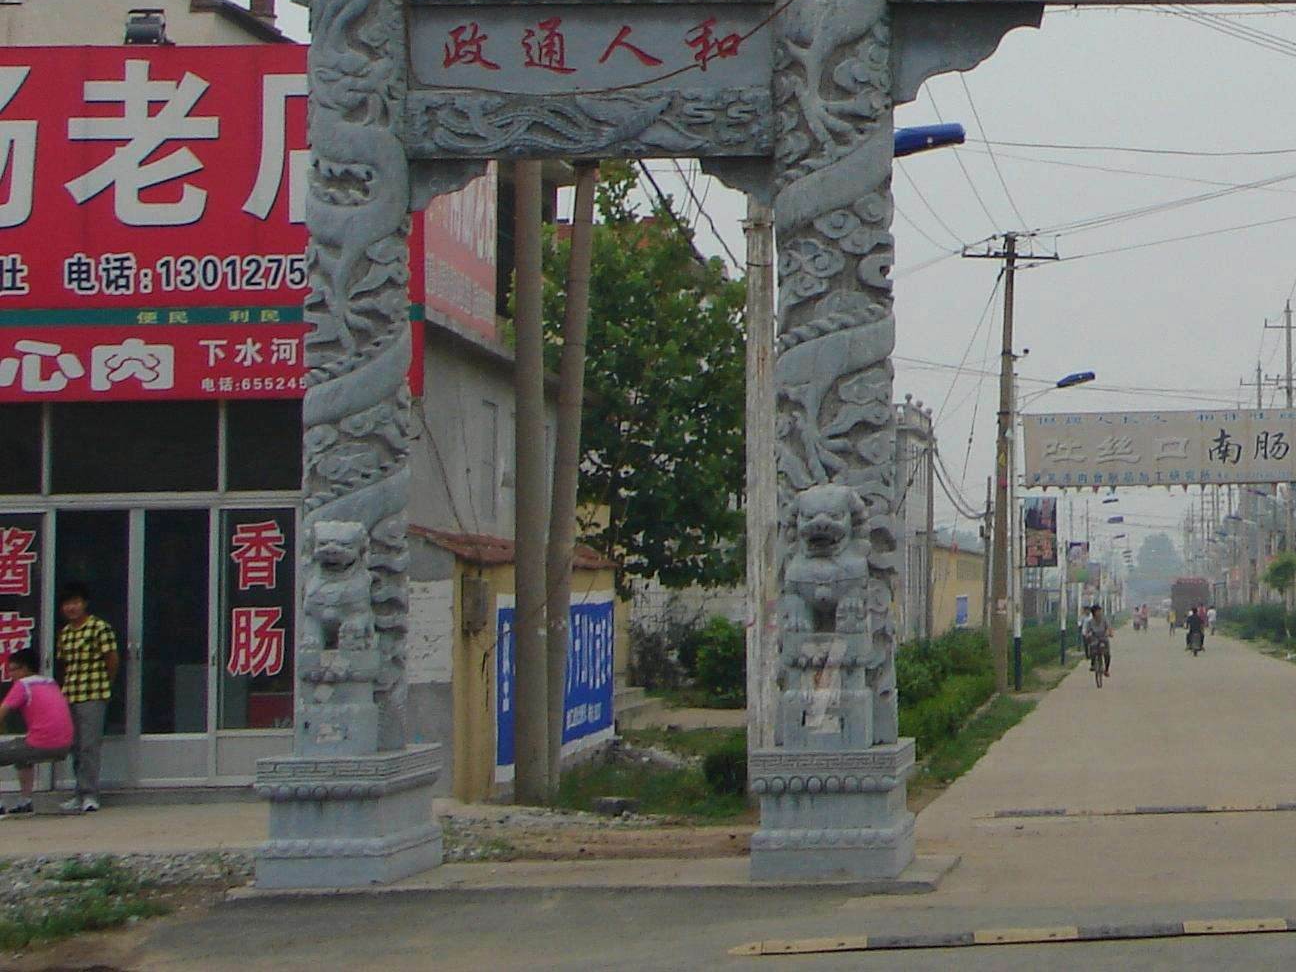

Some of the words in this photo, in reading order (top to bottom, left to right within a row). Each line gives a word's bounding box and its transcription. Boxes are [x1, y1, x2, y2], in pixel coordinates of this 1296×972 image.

[443, 16, 741, 74] 政通人和
[199, 337, 299, 367] 下水河
[227, 519, 286, 677] 香肠
